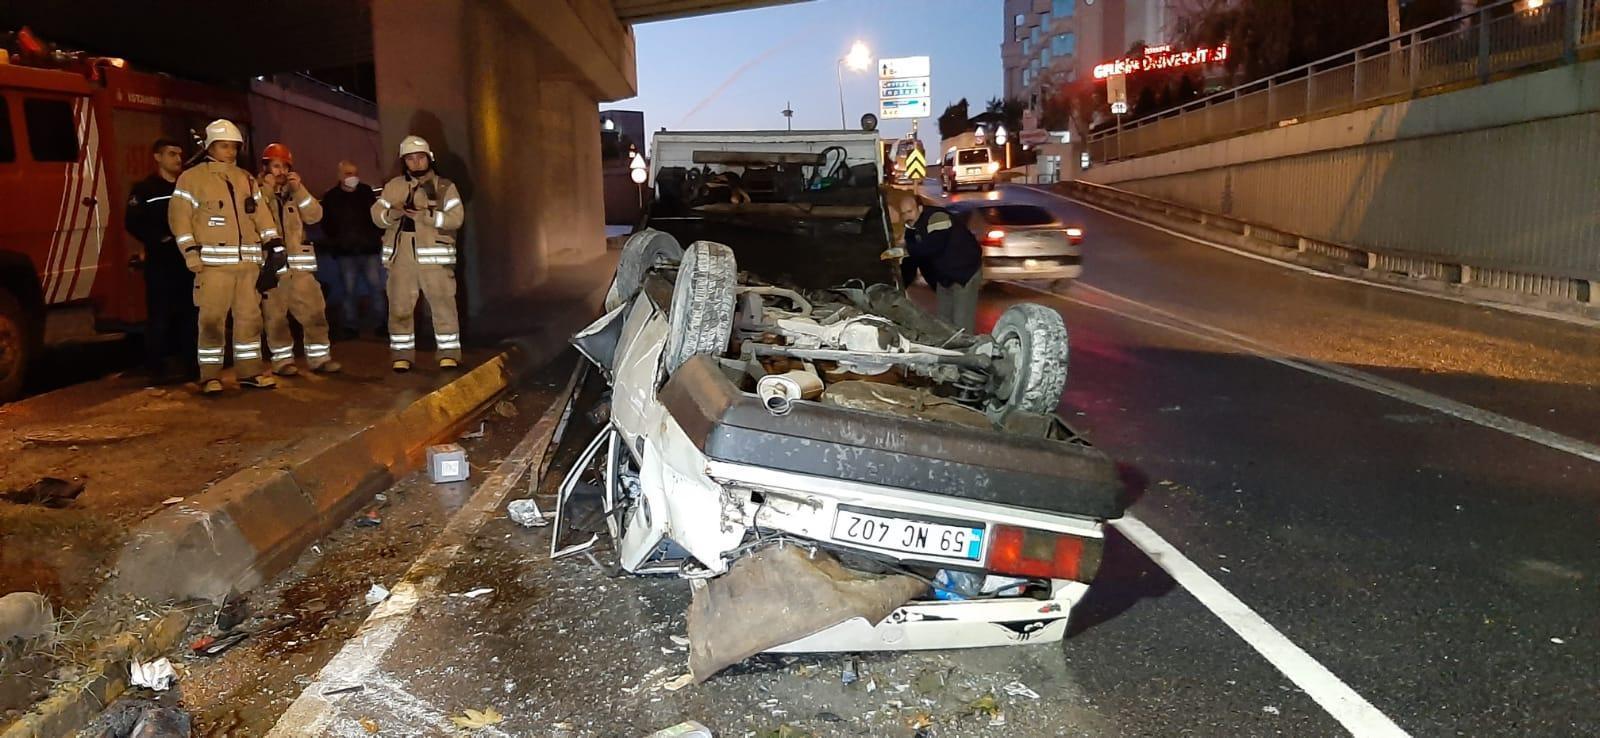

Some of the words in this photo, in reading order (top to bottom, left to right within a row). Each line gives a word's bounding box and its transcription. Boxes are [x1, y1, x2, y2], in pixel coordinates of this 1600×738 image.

[1142, 44, 1227, 71] İVERSİTSİ
[847, 517, 890, 543] 402
[902, 525, 928, 549] NC
[940, 530, 965, 552] 59
